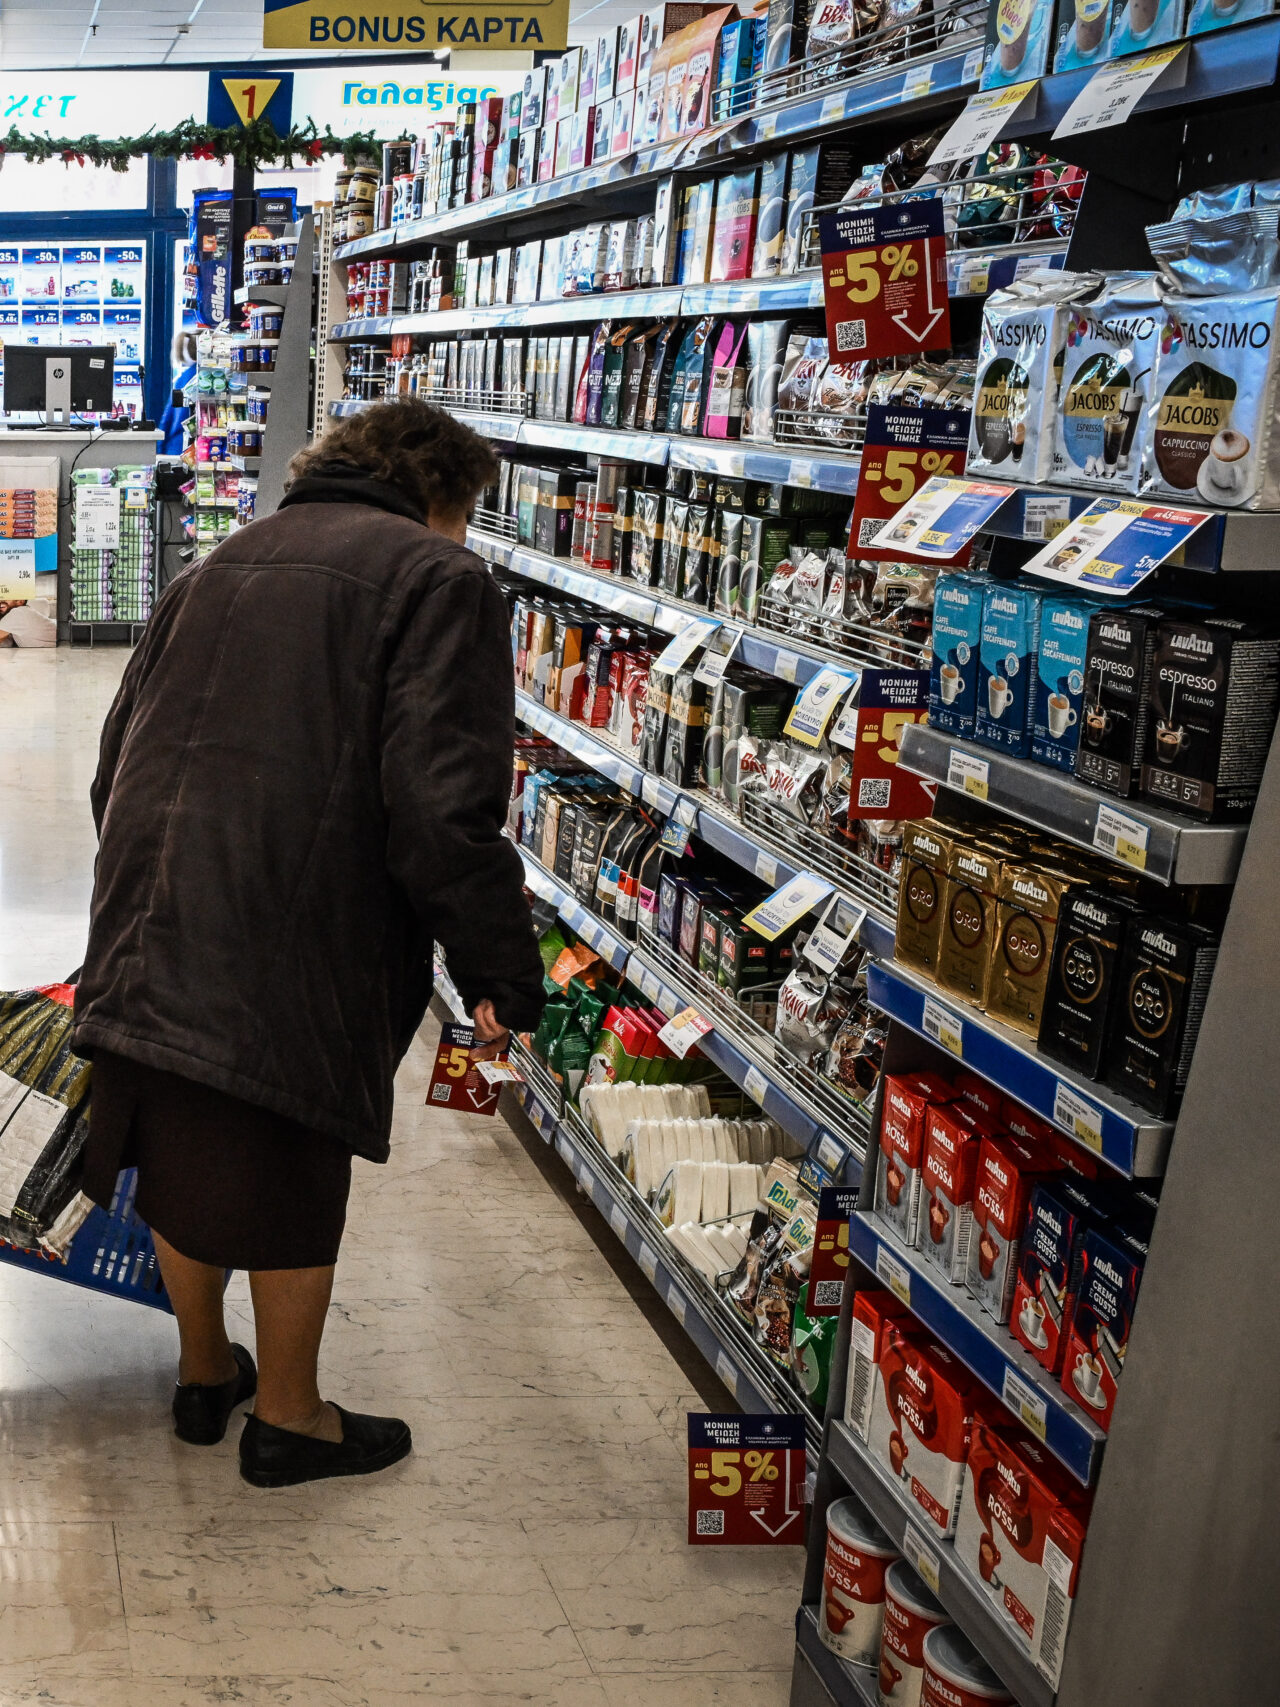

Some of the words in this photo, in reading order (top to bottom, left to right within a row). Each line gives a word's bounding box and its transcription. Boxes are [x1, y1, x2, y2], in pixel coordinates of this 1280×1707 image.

[309, 16, 425, 43] BONUS
[437, 17, 544, 43] ΚΑΡΤΑ
[241, 85, 257, 118] 1
[342, 81, 497, 113] Γαλαξίας
[836, 218, 874, 230] ΜΟΝΙΜΗ
[840, 226, 875, 239] ΜΕΙΩΣΗ
[849, 234, 876, 245] ΤΙΜΗΣ
[117, 250, 139, 261] -50%
[829, 244, 919, 304] -5%
[830, 268, 844, 276] ΑΠΟ
[210, 265, 227, 323] Gillette
[992, 324, 1047, 347] TASSIMO
[1180, 321, 1271, 349] TASSIMO
[54, 368, 64, 379] hp
[115, 374, 138, 385] -50%
[1071, 393, 1116, 411] JACOBS
[885, 415, 924, 426] ΜΟΝΙΜΗ
[1164, 405, 1220, 427] JACOBS
[886, 425, 923, 435] ΜΕΙΩΣΗ
[894, 433, 921, 443] ΤΙΜΗΣ
[1076, 423, 1103, 432] ESPRESSO
[1161, 437, 1210, 451] CAPPUCCINO
[868, 461, 882, 469] ΑΠΟ
[1171, 451, 1197, 460] CLASSICO
[1119, 504, 1145, 514] BONUS
[1161, 511, 1172, 519] 45
[1091, 563, 1115, 575] -1,35€
[941, 590, 969, 606] LAVAZZA
[991, 597, 1018, 615] LAVAZZA
[935, 616, 949, 625] CAFFÈ
[935, 625, 969, 637] DECAFFEINATO
[1051, 611, 1083, 630] LAVAZZA
[984, 634, 1017, 649] DECAFFEINATO
[1099, 623, 1131, 643] LAVAZZA
[1170, 634, 1214, 655] LAVAZZA
[1090, 657, 1134, 679] espresso
[878, 678, 919, 688] ΜΟΝΙΜΗ
[1107, 680, 1133, 693] ITALIANO
[1159, 667, 1217, 692] espresso
[881, 687, 919, 696] ΜΕΙΩΣΗ
[889, 694, 918, 704] ΤΙΜΗΣ
[1182, 693, 1215, 708] ITALIANO
[913, 836, 940, 856] LAVAZZA
[957, 856, 988, 879] LAVAZZA
[910, 886, 934, 908] ORO
[1012, 879, 1048, 903] LAVAZZA
[954, 910, 982, 932] ORO
[1072, 899, 1107, 926] LAVAZZA
[1009, 936, 1040, 959] ORO
[1141, 928, 1177, 957] LAVAZZA
[1066, 961, 1096, 985] ORO
[1134, 994, 1164, 1019] ORO
[890, 1093, 911, 1119] LAVAZZA
[885, 1121, 910, 1153] ROSSA
[932, 1125, 955, 1152] LAVAZZA
[927, 1155, 954, 1190] ROSSA
[985, 1156, 1008, 1187] LAVAZZA
[978, 1188, 1005, 1225] ROSSA
[1036, 1205, 1062, 1236] LAVAZZA
[1035, 1228, 1057, 1251] CREMA
[1037, 1240, 1058, 1263] GUSTO
[1093, 1256, 1123, 1289] LAVAZZA
[1092, 1280, 1117, 1306] CREMA
[1093, 1292, 1118, 1318] GUSTO
[897, 1394, 925, 1435] ROSSA
[703, 1421, 740, 1431] ΜΟΝΙΜΗ
[706, 1429, 740, 1438] ΜΕΙΩΣΗ
[715, 1436, 740, 1445] ΤΙΜΗΣ
[694, 1450, 779, 1497] -5%
[987, 1496, 1019, 1542] ROSSA
